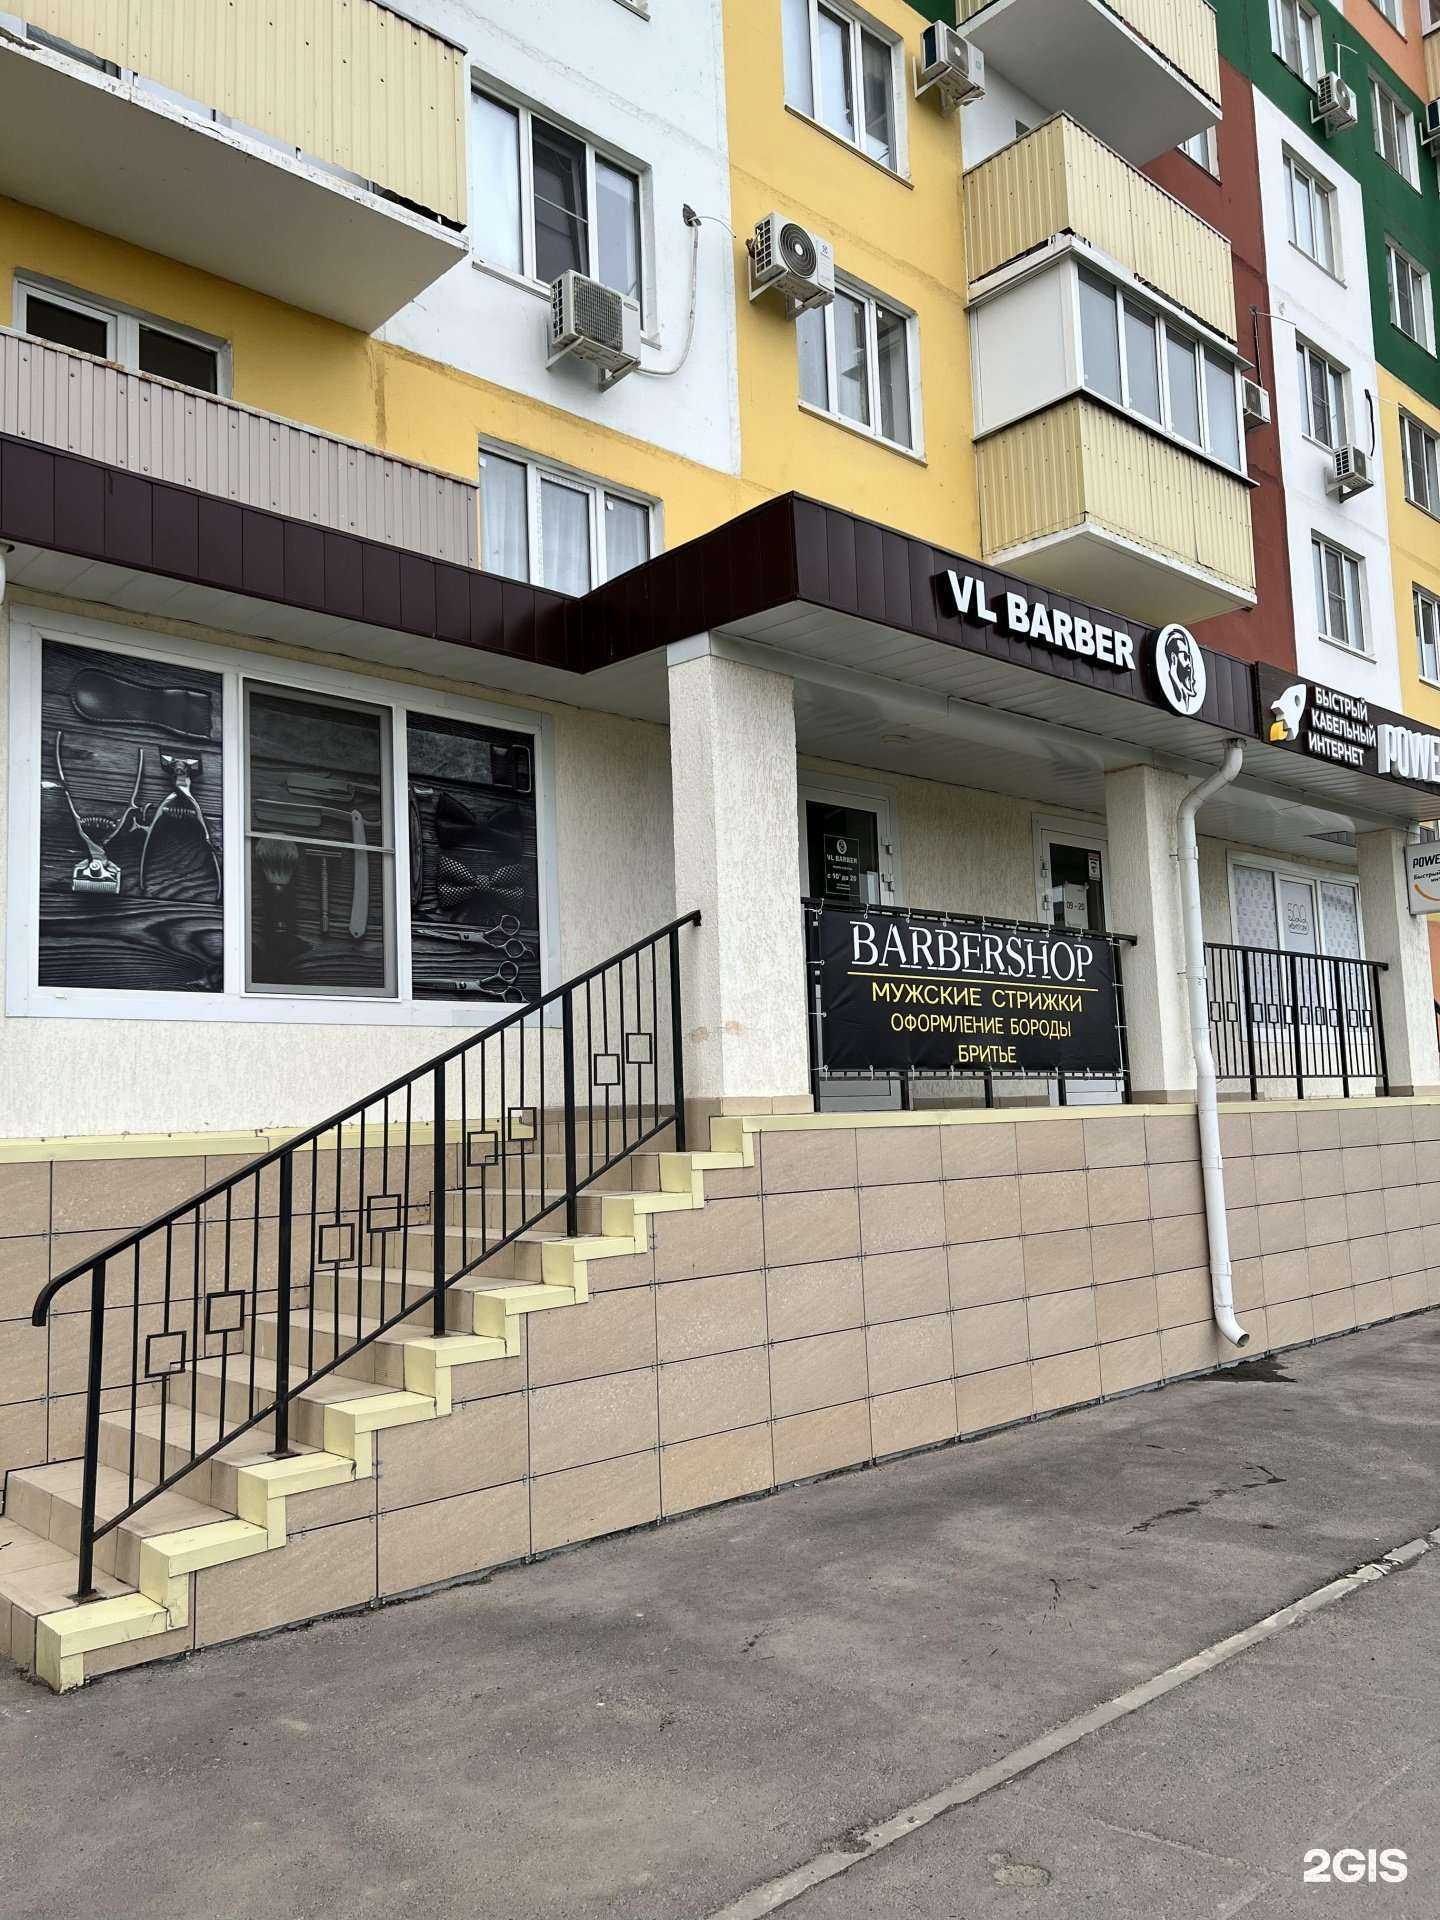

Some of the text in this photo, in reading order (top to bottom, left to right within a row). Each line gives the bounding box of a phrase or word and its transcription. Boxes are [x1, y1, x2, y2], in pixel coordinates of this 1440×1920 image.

[947, 569, 1136, 671] VL BARBER
[1315, 686, 1368, 722] БЫСТРЫЙ
[1311, 708, 1377, 748] КАБЕЛЬНЫЙ
[1308, 731, 1365, 767] ИНТЕРНЕТ
[849, 921, 1093, 981] BARBERSHOP
[872, 982, 1082, 1013] МУЖСКИЕ СТРИЖКИ
[890, 1012, 1072, 1040] ОФОРМЛЕНИЕ БОРОДЫ
[957, 1044, 1017, 1064] БРИТЬЕ
